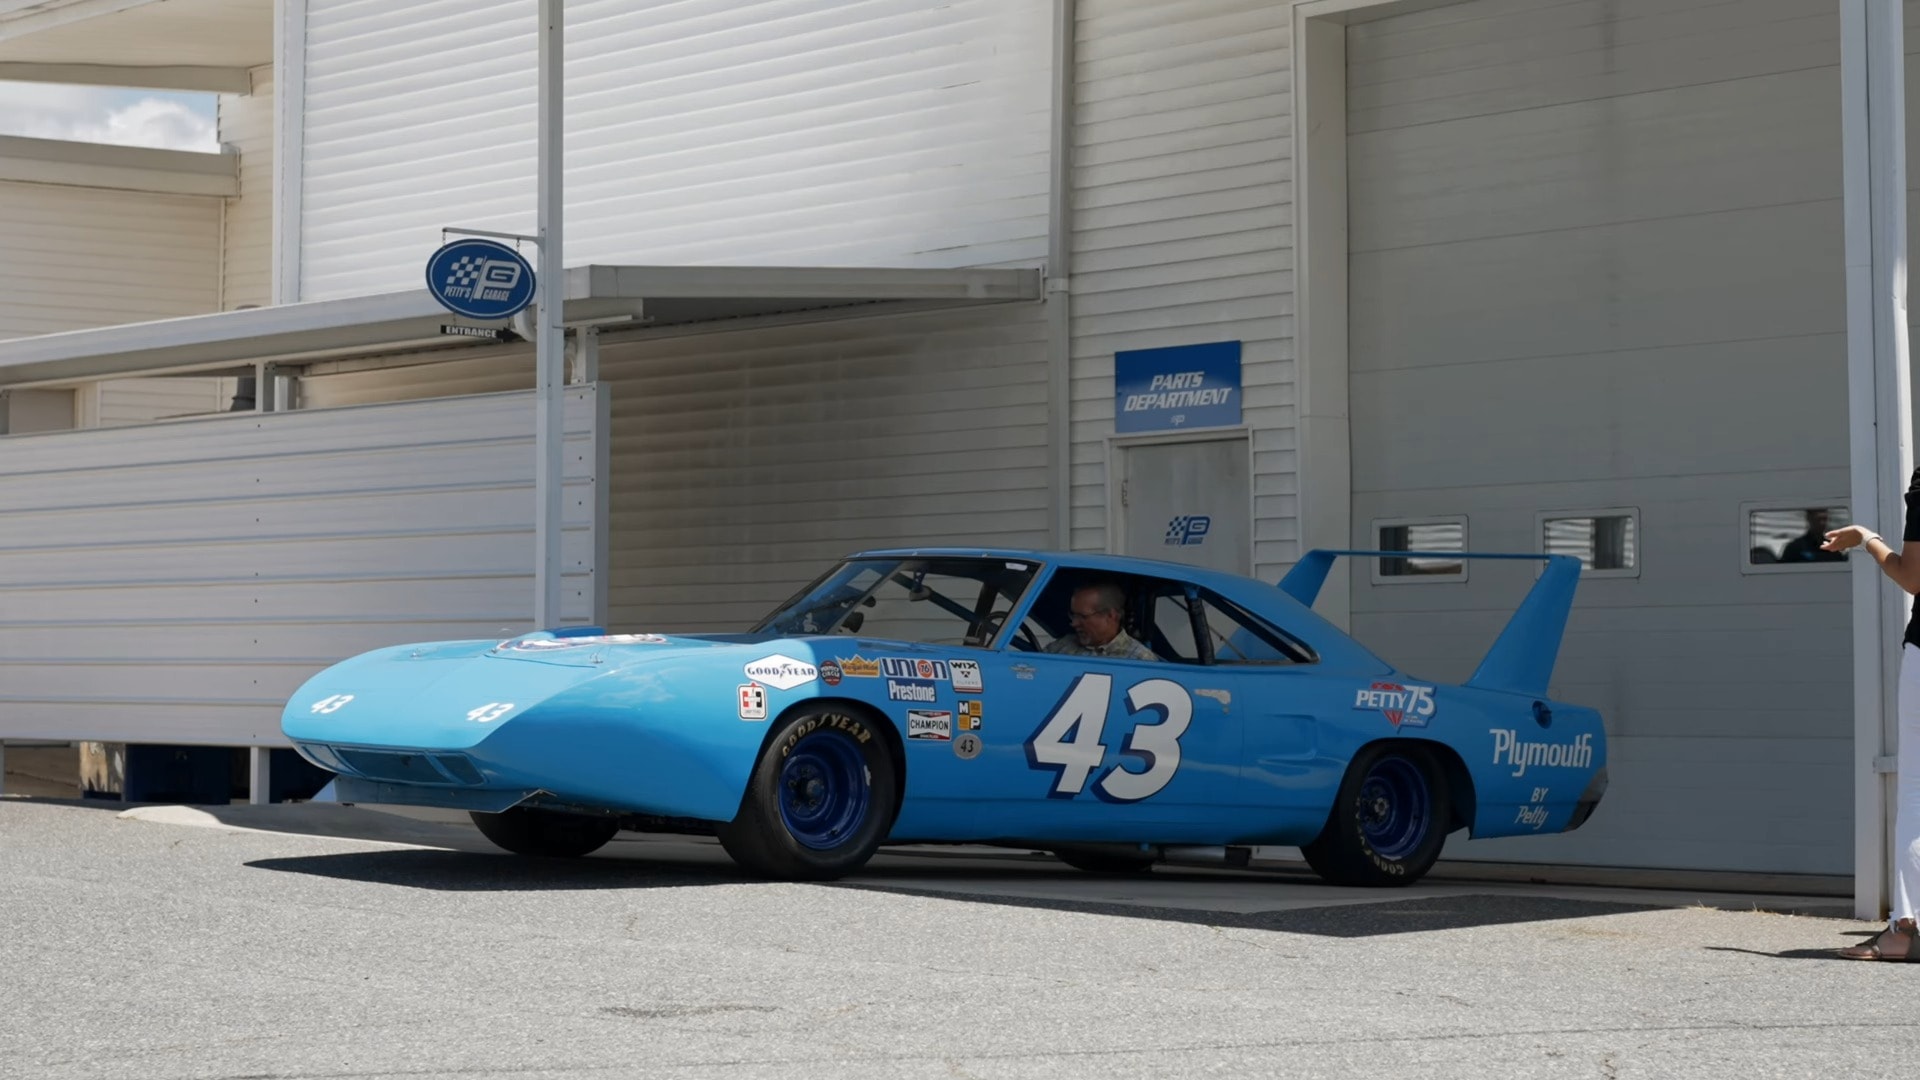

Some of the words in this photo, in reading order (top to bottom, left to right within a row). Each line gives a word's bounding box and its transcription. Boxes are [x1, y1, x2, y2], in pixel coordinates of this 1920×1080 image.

[444, 286, 471, 299] PETTY'S
[482, 289, 510, 301] GARAGE
[446, 326, 497, 338] ENTRANCE
[1150, 371, 1204, 391] PARTS
[1124, 387, 1232, 412] DEPARTMENT
[951, 662, 977, 670] WIX
[888, 680, 935, 702] Prestone
[1356, 690, 1407, 709] PETTY
[1404, 685, 1434, 715] 75
[311, 695, 354, 714] 43
[467, 703, 514, 722] 43
[911, 719, 949, 730] CHAMPION
[961, 740, 974, 753] 43
[1024, 672, 1193, 803] 43
[1489, 728, 1592, 777] Plymouth
[1531, 787, 1548, 802] BY
[1514, 805, 1549, 830] Petty
